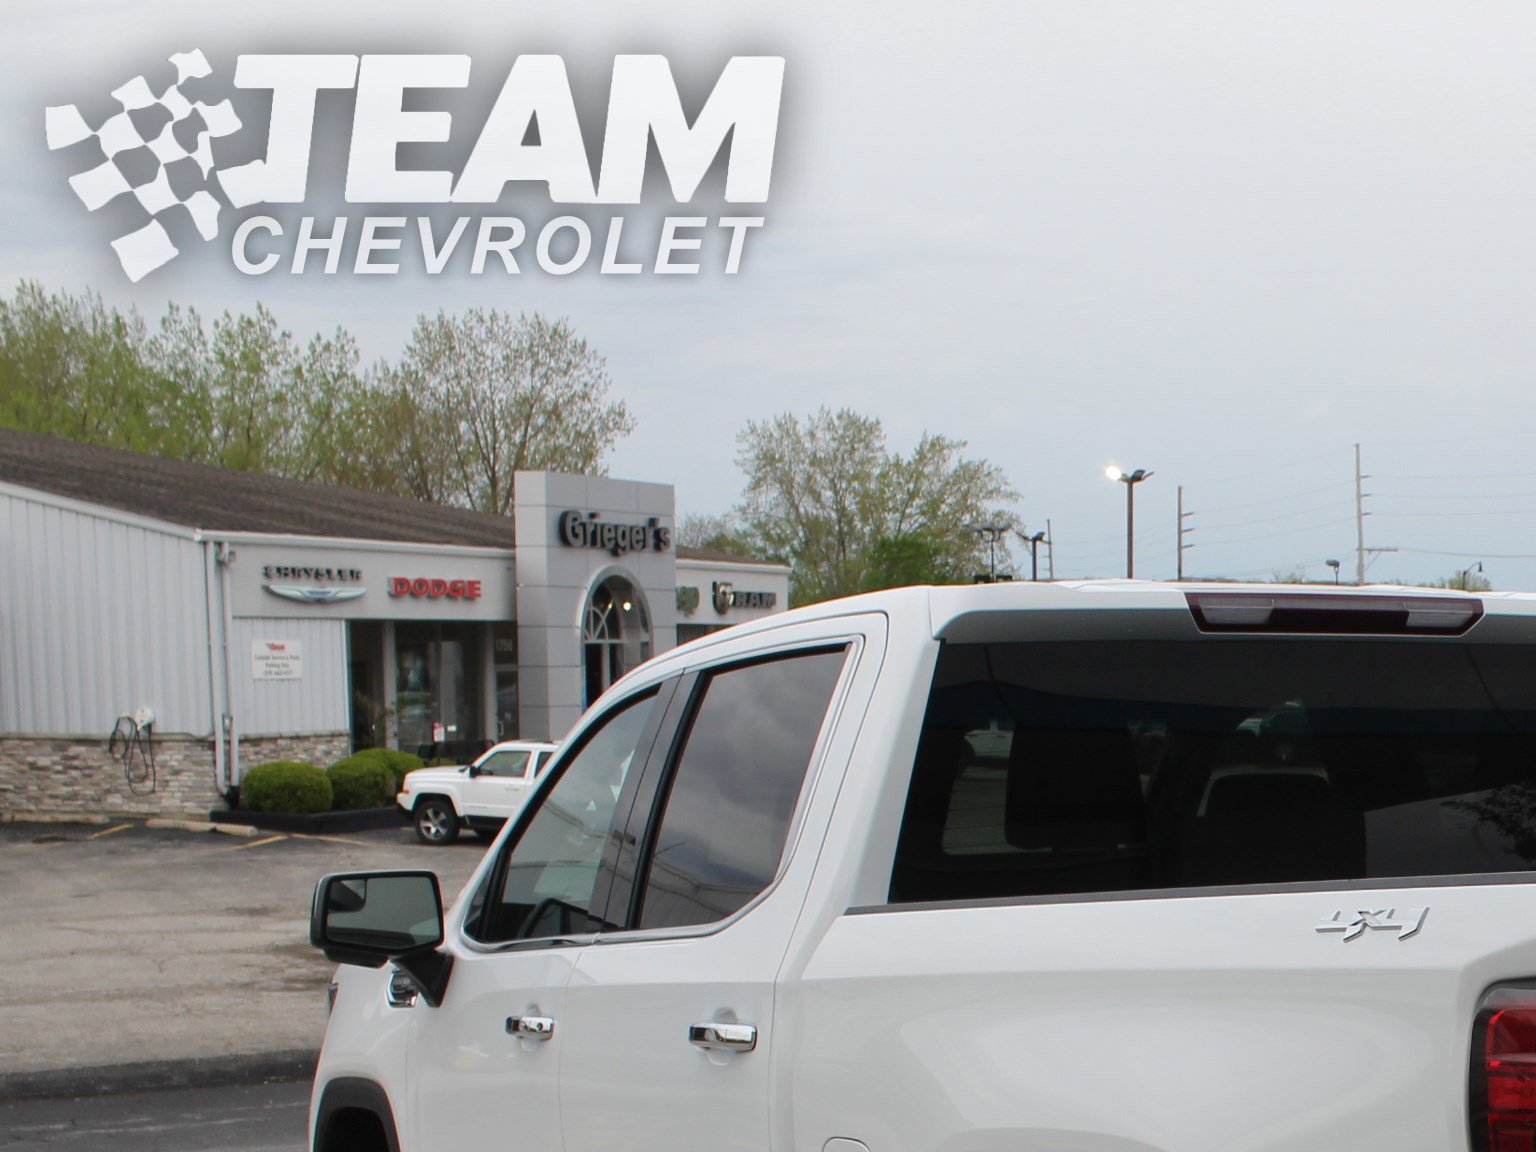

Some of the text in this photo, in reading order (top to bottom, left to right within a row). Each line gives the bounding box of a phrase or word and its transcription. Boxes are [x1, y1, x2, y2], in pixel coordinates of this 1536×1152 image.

[560, 510, 671, 556] Grieger's
[390, 577, 482, 600] DODGE
[732, 592, 777, 608] RAM
